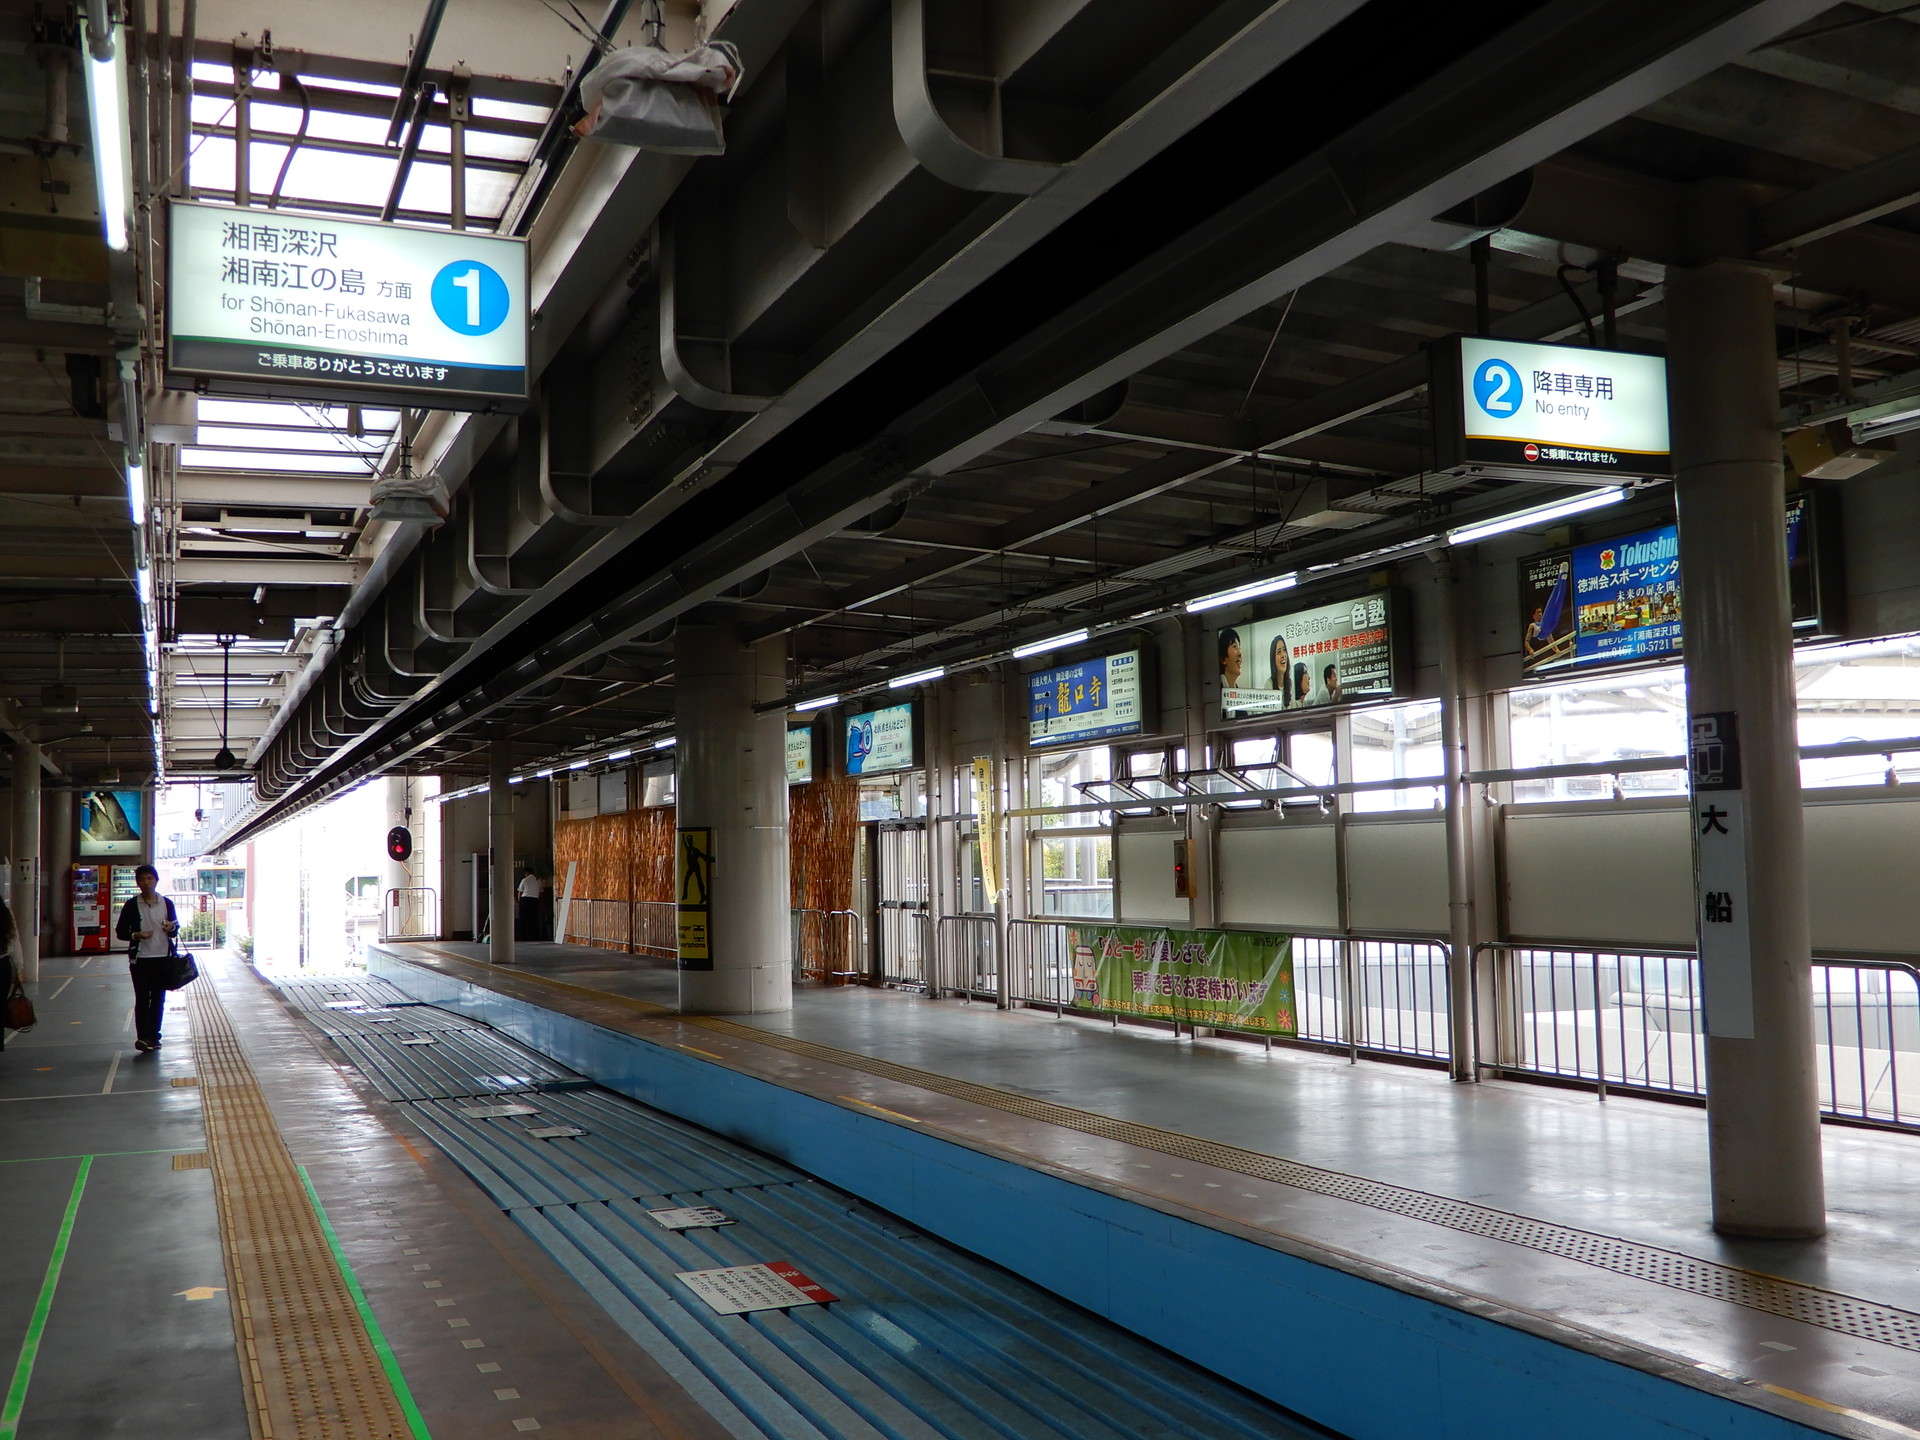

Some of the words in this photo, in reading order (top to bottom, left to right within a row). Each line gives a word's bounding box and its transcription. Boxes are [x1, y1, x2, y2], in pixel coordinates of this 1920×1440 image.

[221, 221, 338, 259] 湘南深沢
[221, 255, 366, 296] 湘南江の島
[376, 280, 412, 300] 方面
[221, 293, 245, 310] for
[250, 295, 411, 326] Shōnan-Fukasawa
[452, 268, 480, 327] 1
[250, 316, 408, 346] Shōnan-Enoshima
[257, 353, 448, 381] ご乗車ありがとうございます
[1485, 365, 1513, 412] 2
[1533, 370, 1614, 400] 降車専用
[1535, 399, 1554, 415] No
[1557, 403, 1590, 420] entry
[1540, 448, 1617, 464] ご乗車になれません
[1539, 558, 1552, 567] 2012
[1333, 598, 1386, 631] 一色塾
[1056, 675, 1102, 715] 龍口寺
[1700, 804, 1733, 923] 大船
[1132, 970, 1271, 1005] 乗車できるお客様がいます
